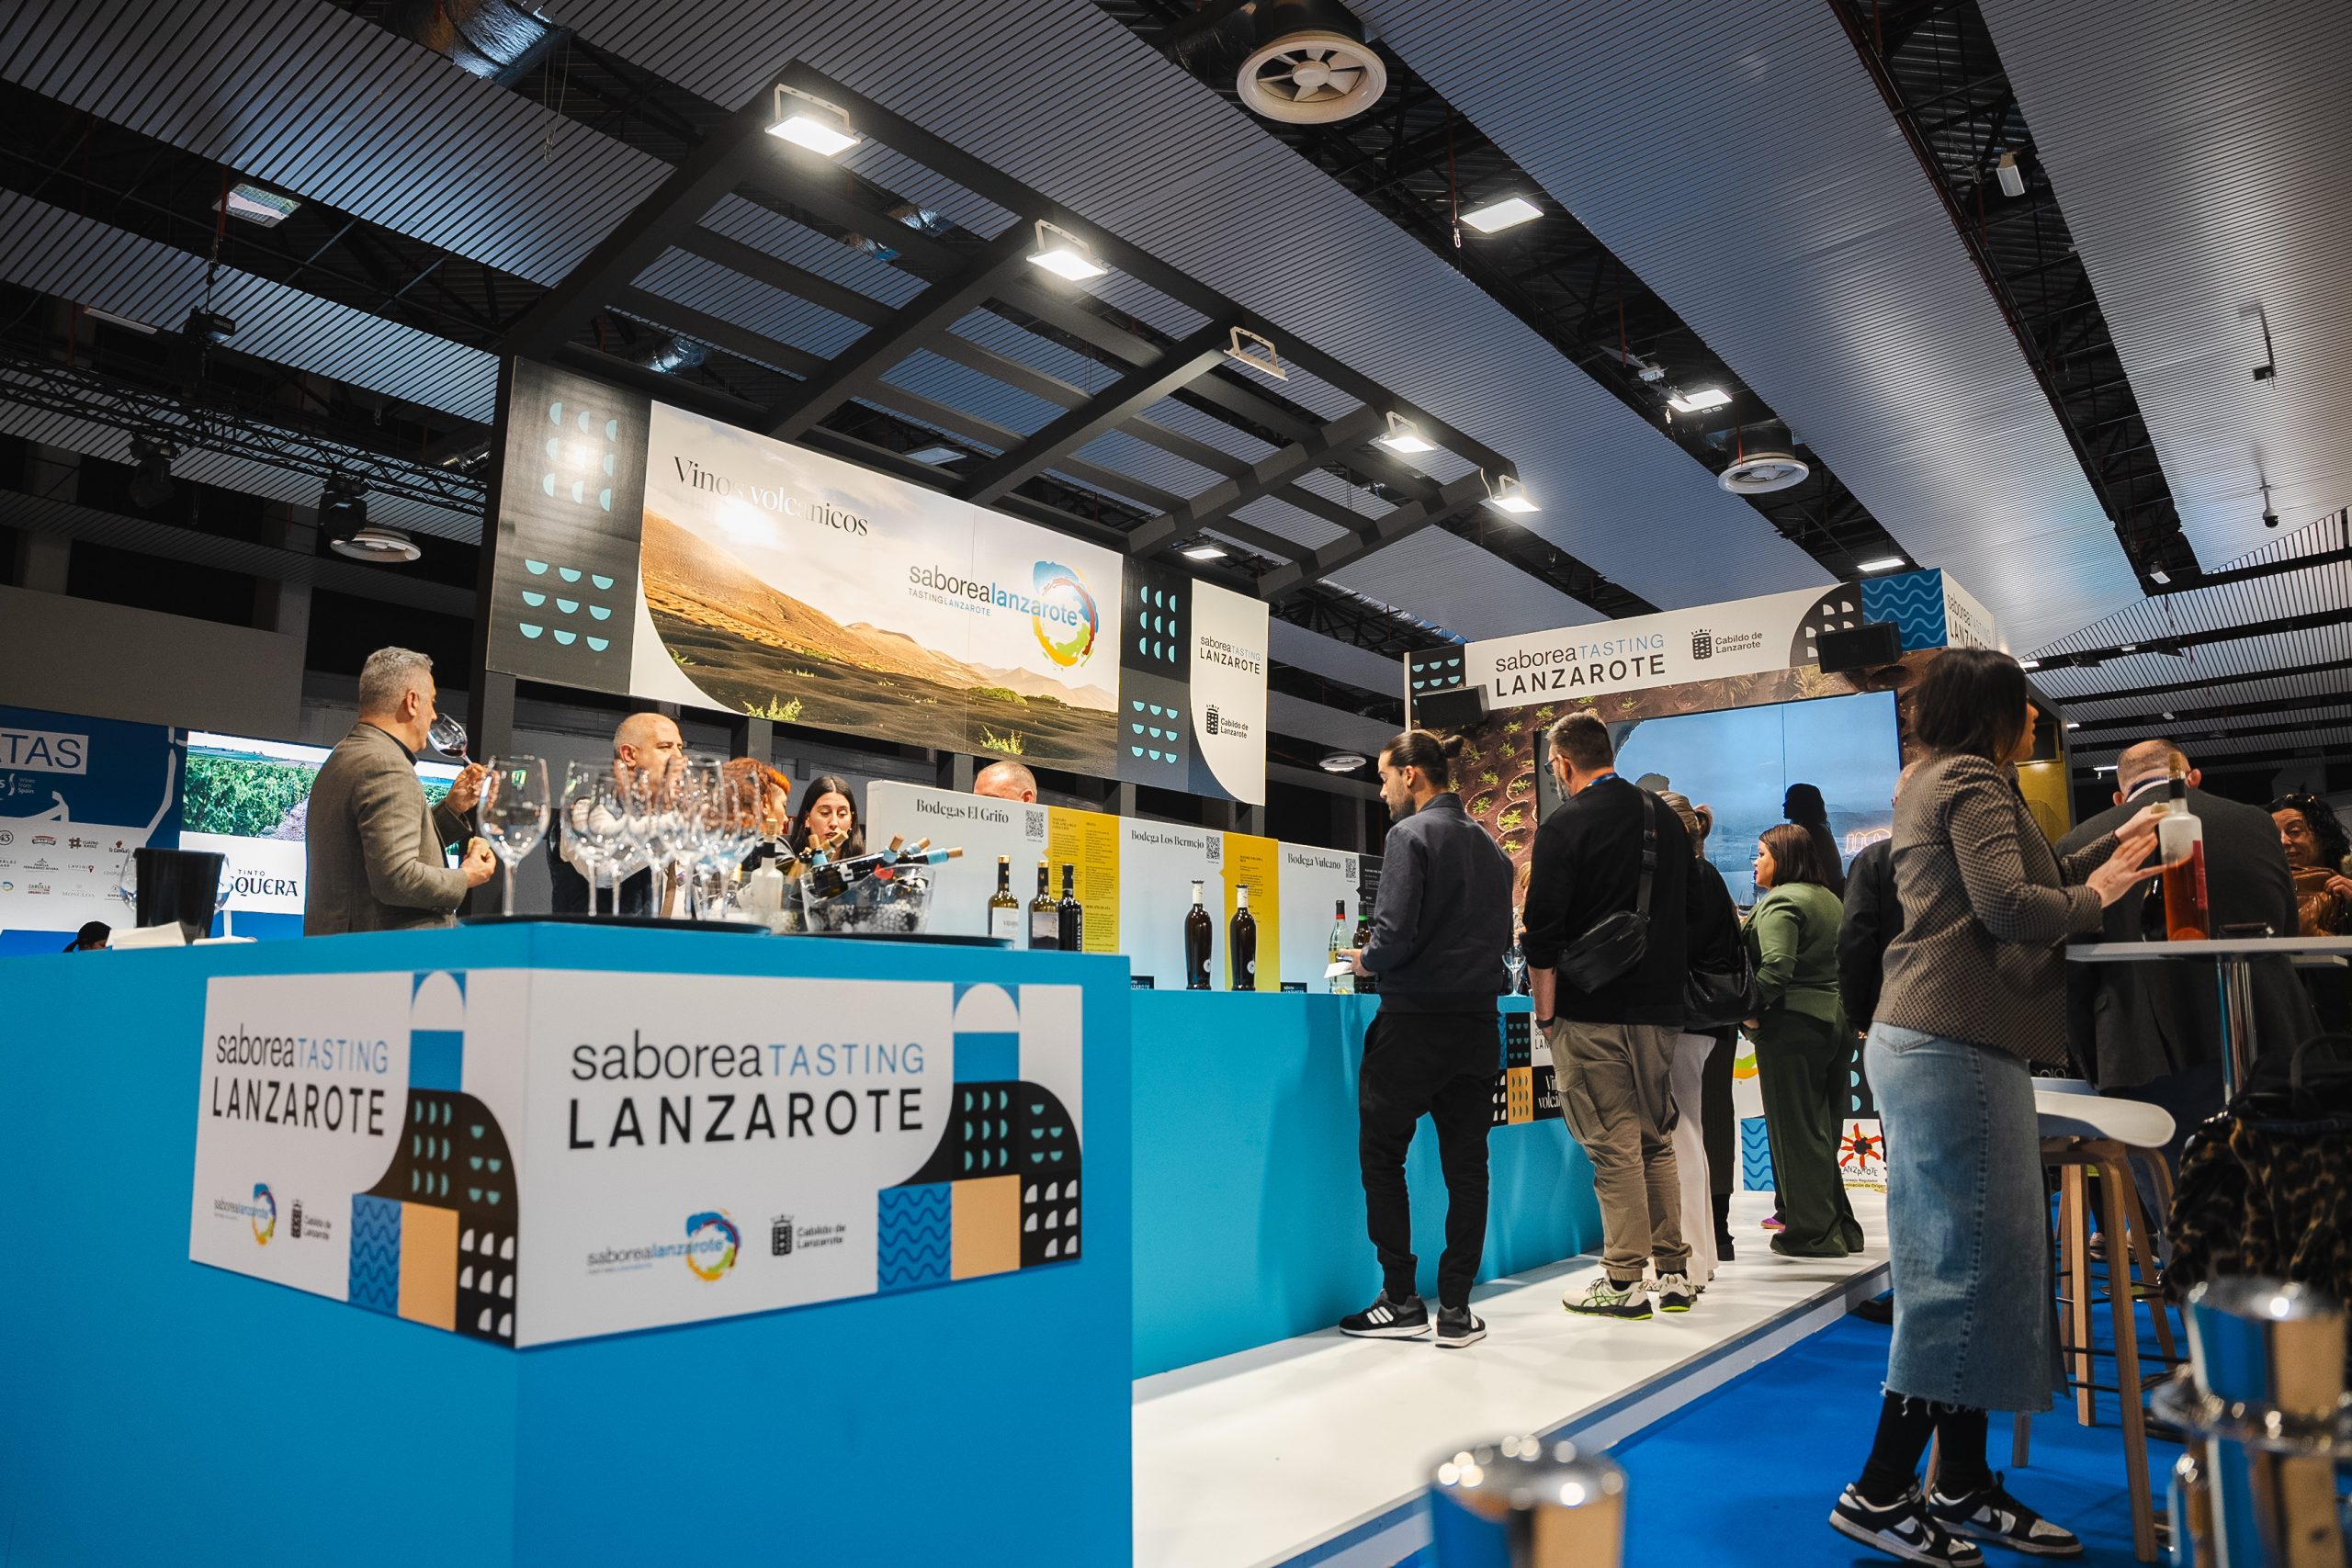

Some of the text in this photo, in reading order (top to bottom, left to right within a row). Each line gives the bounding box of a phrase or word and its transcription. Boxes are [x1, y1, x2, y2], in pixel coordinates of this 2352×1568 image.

[1715, 632, 1763, 645] Cabildo de
[1715, 639, 1761, 654] Lanzarote
[1200, 648, 1261, 675] LANZAROTE
[1496, 653, 1666, 697] LANZAROTE
[1220, 717, 1249, 731] Cabildo de
[1220, 726, 1248, 739] Lanzarote
[0, 733, 81, 769] TAS
[916, 799, 1009, 824] Bodegas El Grifo
[1131, 829, 1159, 845] Bodega
[1160, 834, 1174, 844] Los
[1288, 853, 1341, 869] Bodega Vulcano
[212, 1076, 385, 1137] LANZAROTE
[569, 1088, 923, 1150] LANZAROTE
[1842, 1165, 1878, 1176] ANZAROTE
